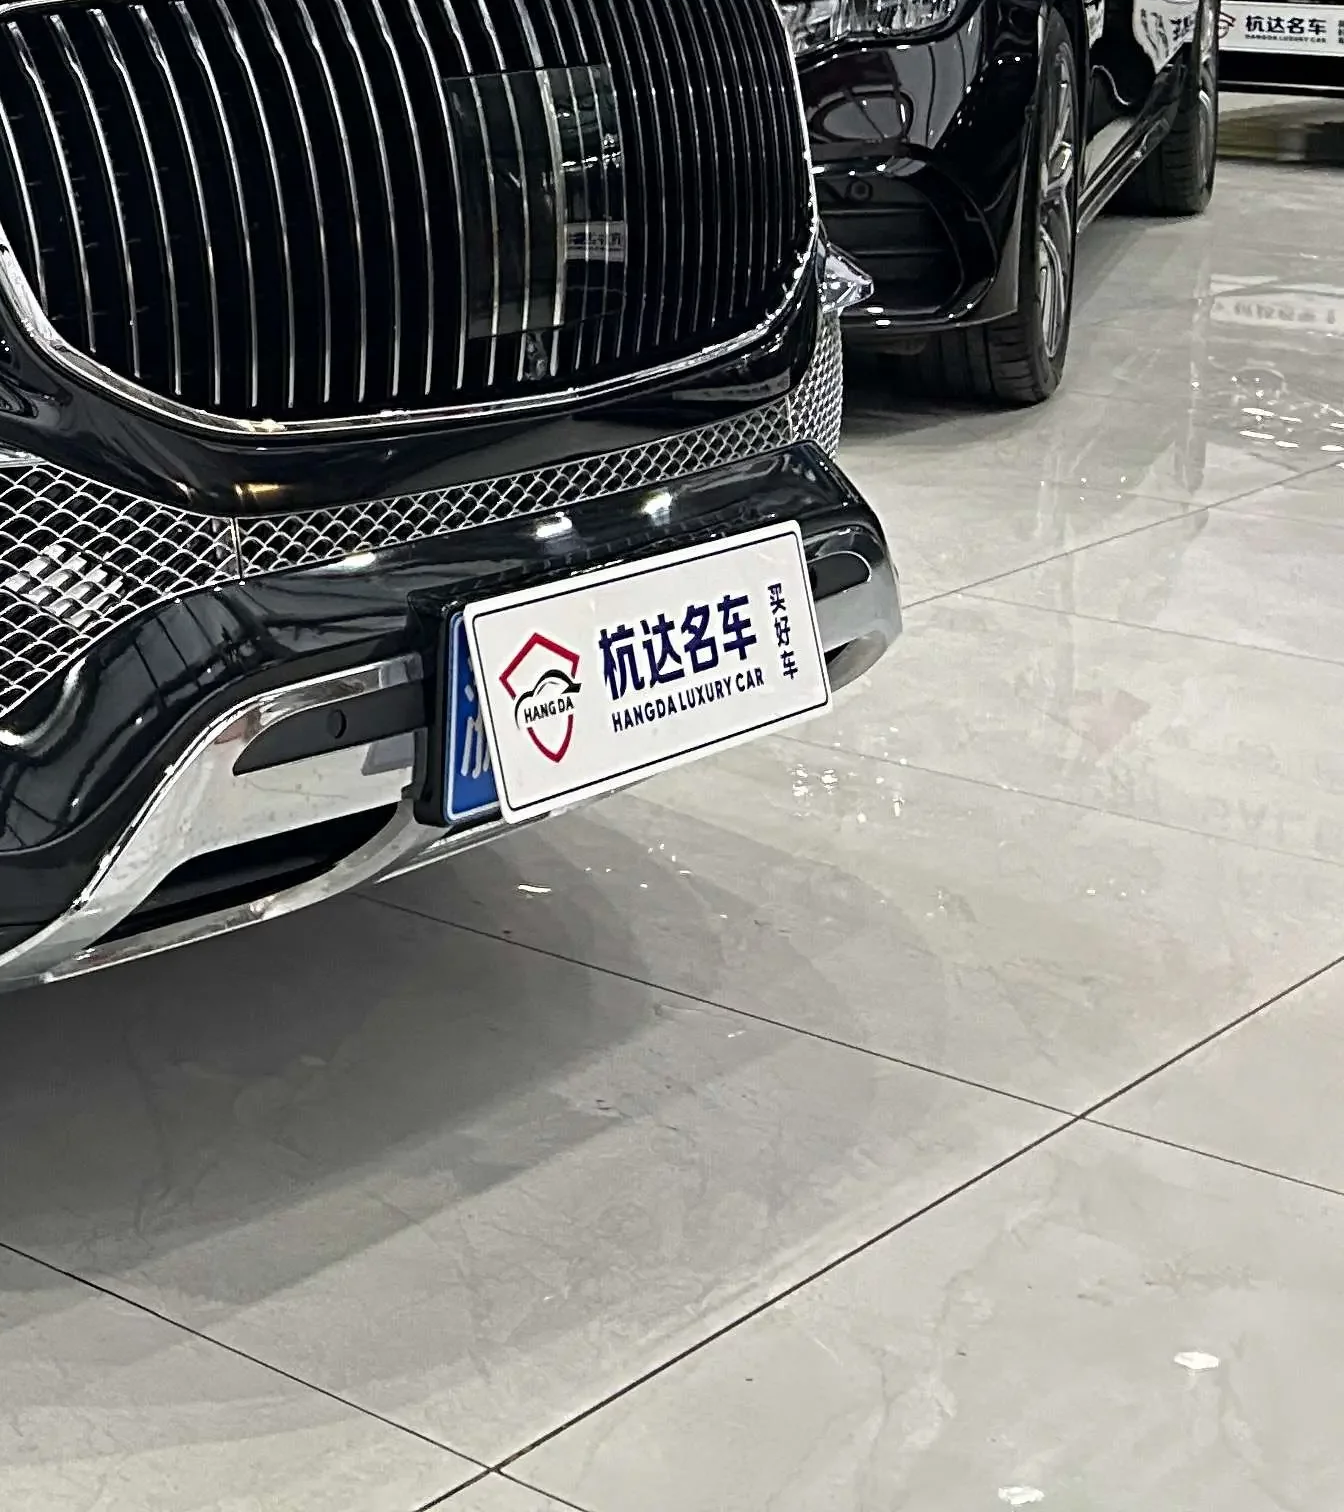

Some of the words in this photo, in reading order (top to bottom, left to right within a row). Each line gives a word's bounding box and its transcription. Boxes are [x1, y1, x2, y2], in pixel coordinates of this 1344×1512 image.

[1246, 15, 1327, 35] 杭达名车
[598, 594, 758, 700] 杭达名车
[767, 582, 799, 681] 买好车
[524, 702, 557, 724] HANG
[558, 696, 574, 712] DA
[612, 699, 678, 733] HANGDA
[678, 679, 733, 715] LUXURY
[736, 667, 765, 695] CAR
